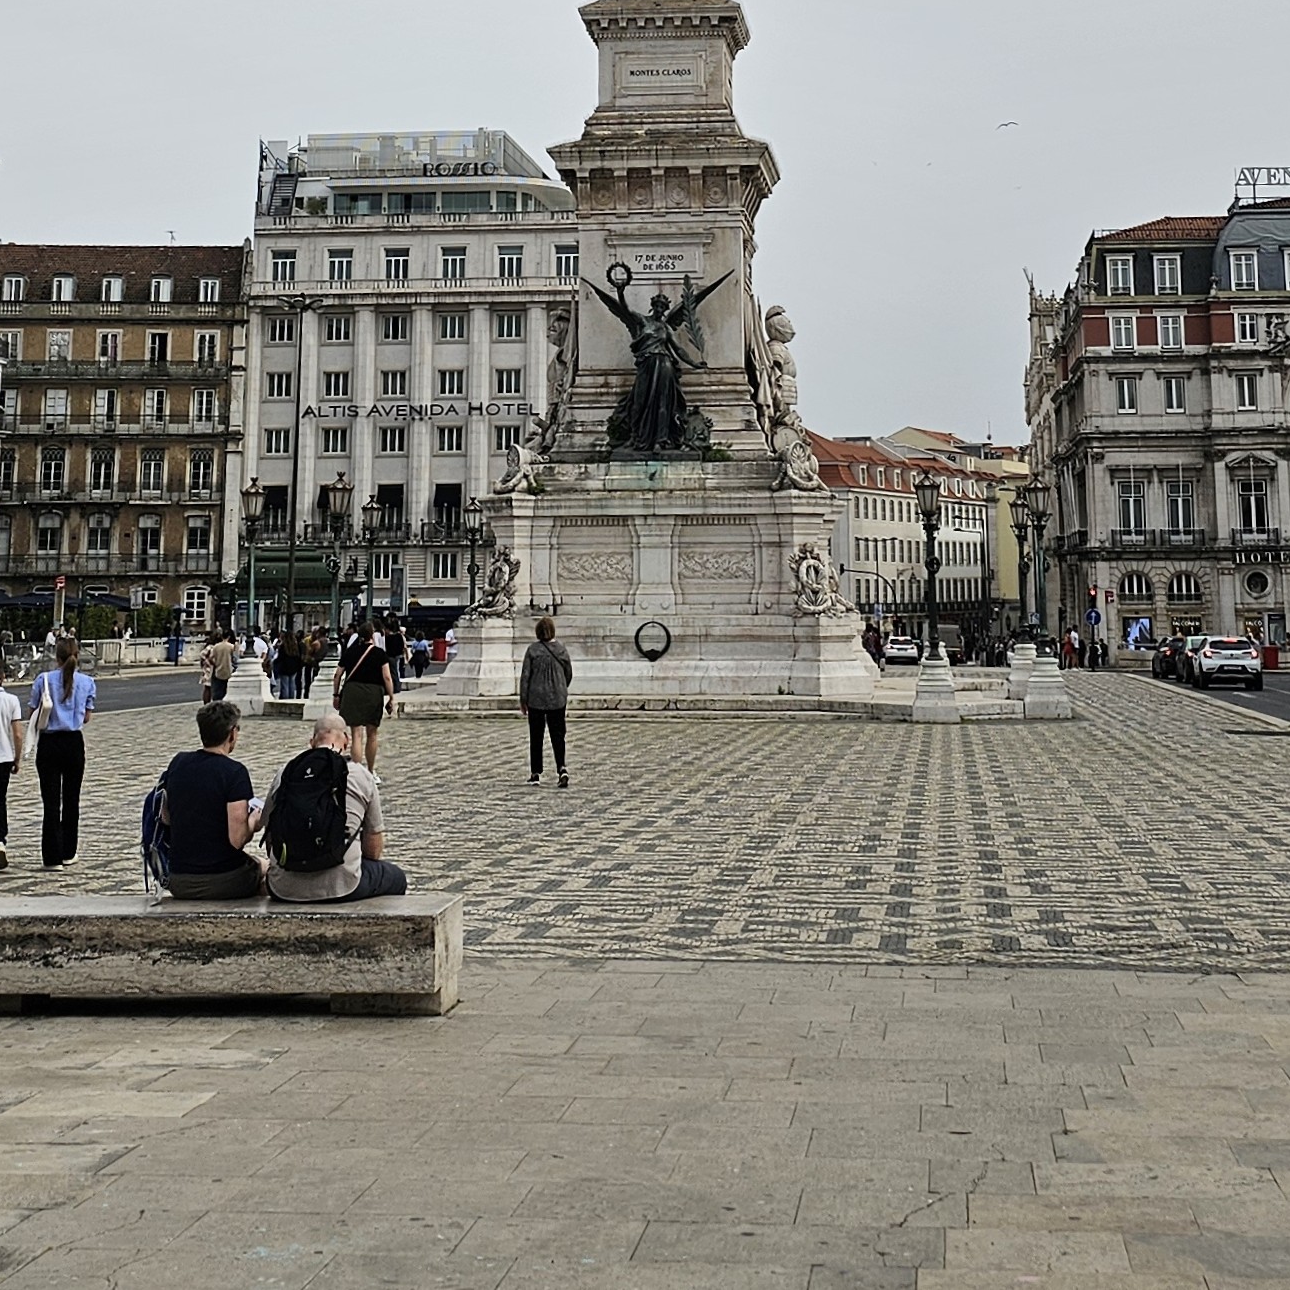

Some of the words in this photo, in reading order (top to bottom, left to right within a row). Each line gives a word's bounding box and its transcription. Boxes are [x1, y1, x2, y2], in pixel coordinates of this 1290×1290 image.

[661, 69, 691, 77] CLAROS
[423, 162, 495, 177] ROSSIO
[635, 254, 643, 263] 17
[655, 261, 676, 270] 1665
[301, 405, 359, 418] ALTIS
[366, 404, 459, 417] AVENIDA
[467, 402, 540, 416] HOTEL
